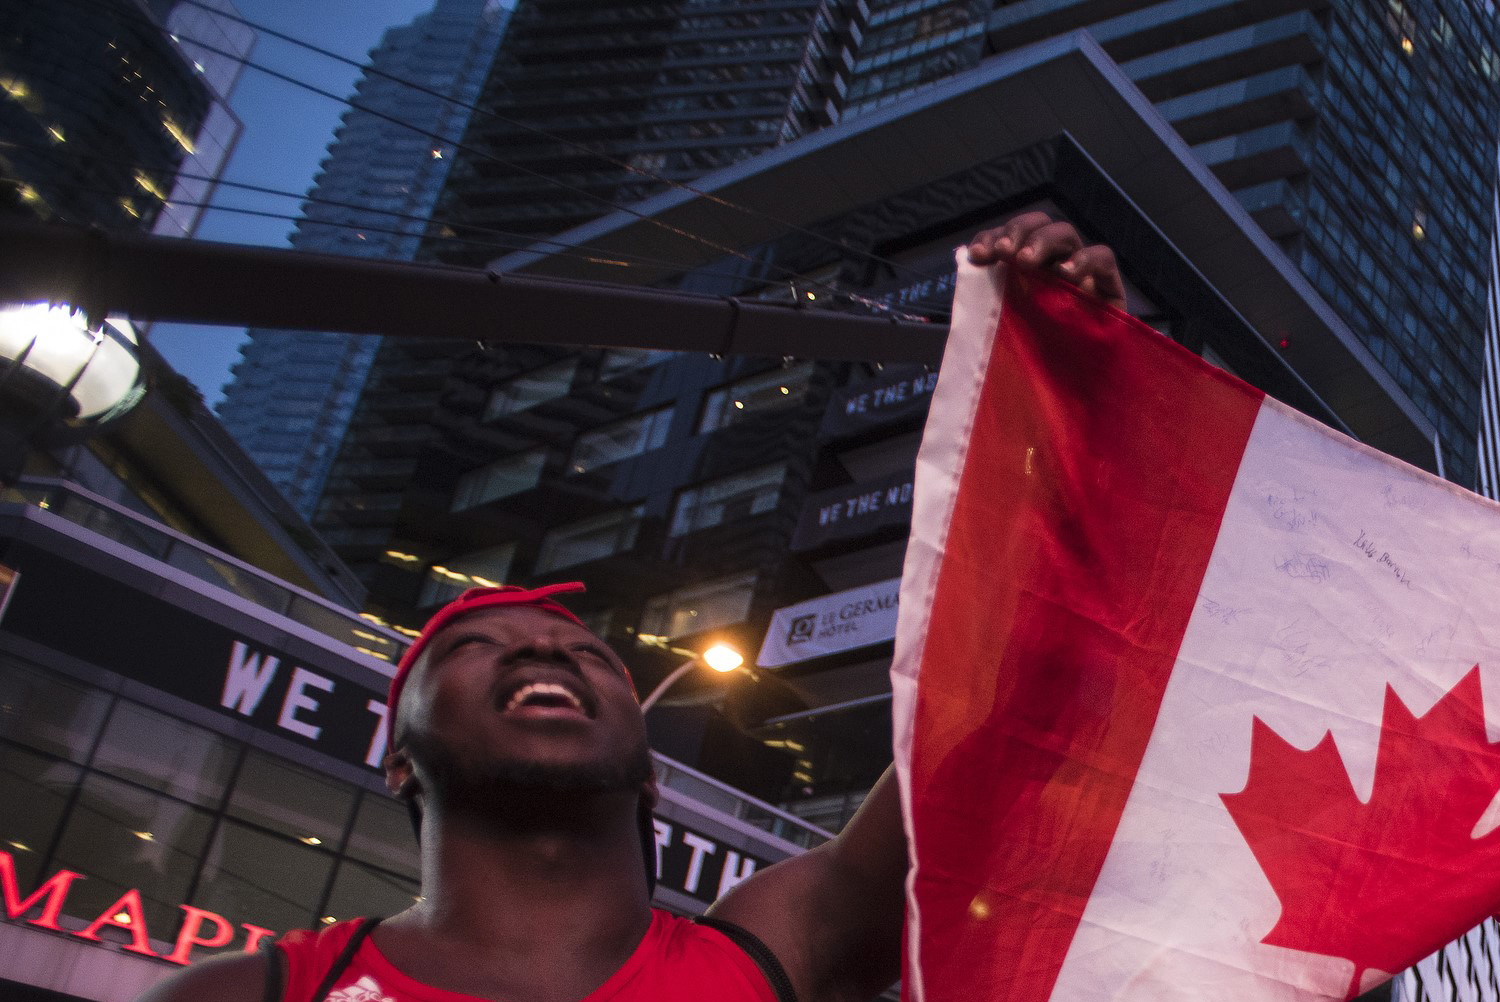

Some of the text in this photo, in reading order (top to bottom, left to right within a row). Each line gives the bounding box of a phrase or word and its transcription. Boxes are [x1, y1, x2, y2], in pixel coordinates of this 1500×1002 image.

[874, 381, 908, 407] THE
[846, 490, 882, 518] THE
[220, 640, 336, 741] WE
